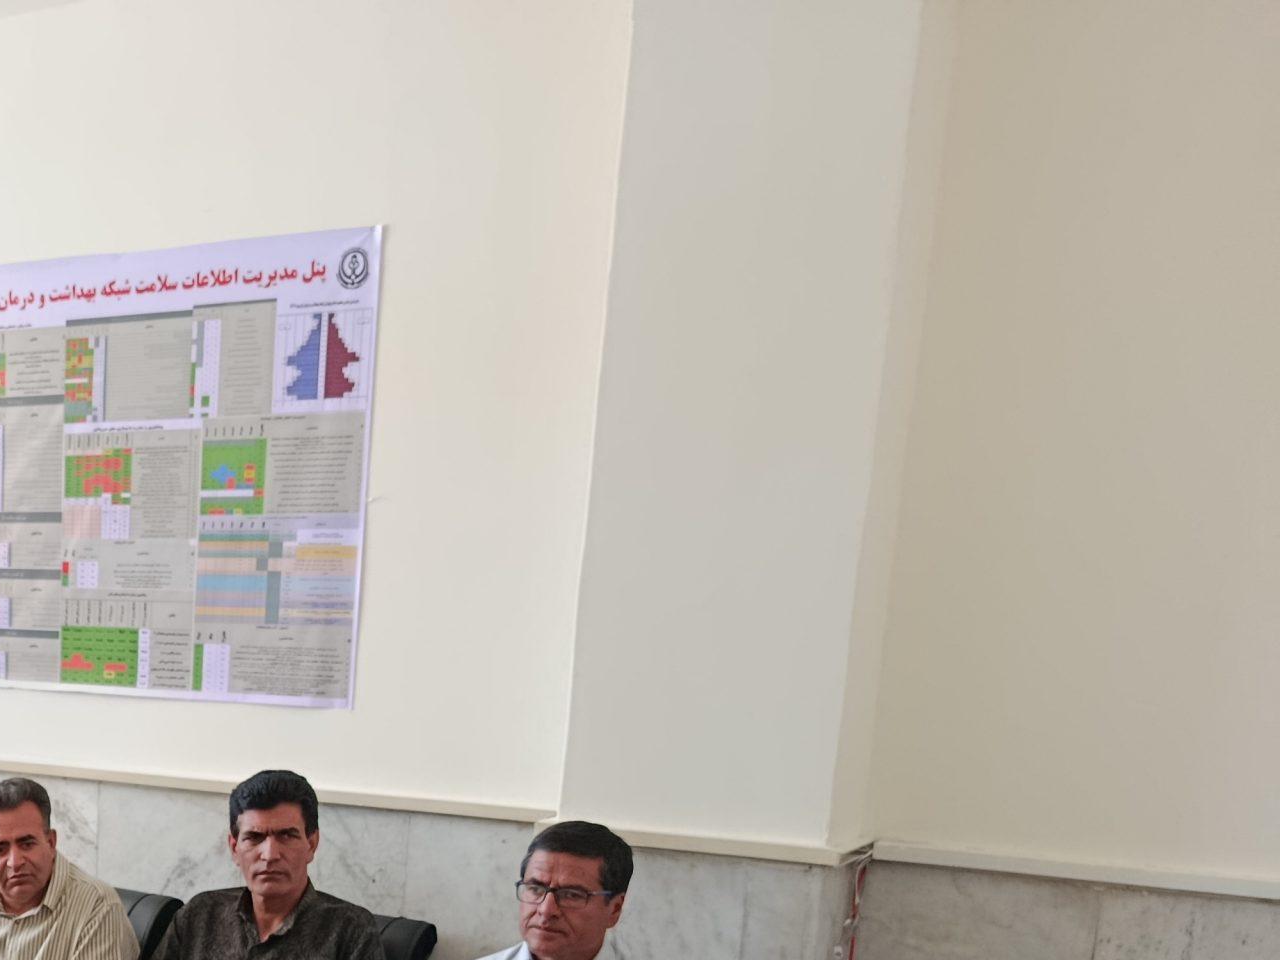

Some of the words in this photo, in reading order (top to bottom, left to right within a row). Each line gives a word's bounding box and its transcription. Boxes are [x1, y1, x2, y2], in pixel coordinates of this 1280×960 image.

[182, 267, 239, 289] اطلاعات
[242, 266, 298, 289] مدیریت
[302, 259, 326, 283] پنل
[49, 284, 96, 304] بهداشت
[101, 278, 131, 300] شبکه
[135, 274, 178, 294] سلامت
[38, 293, 45, 308] و
